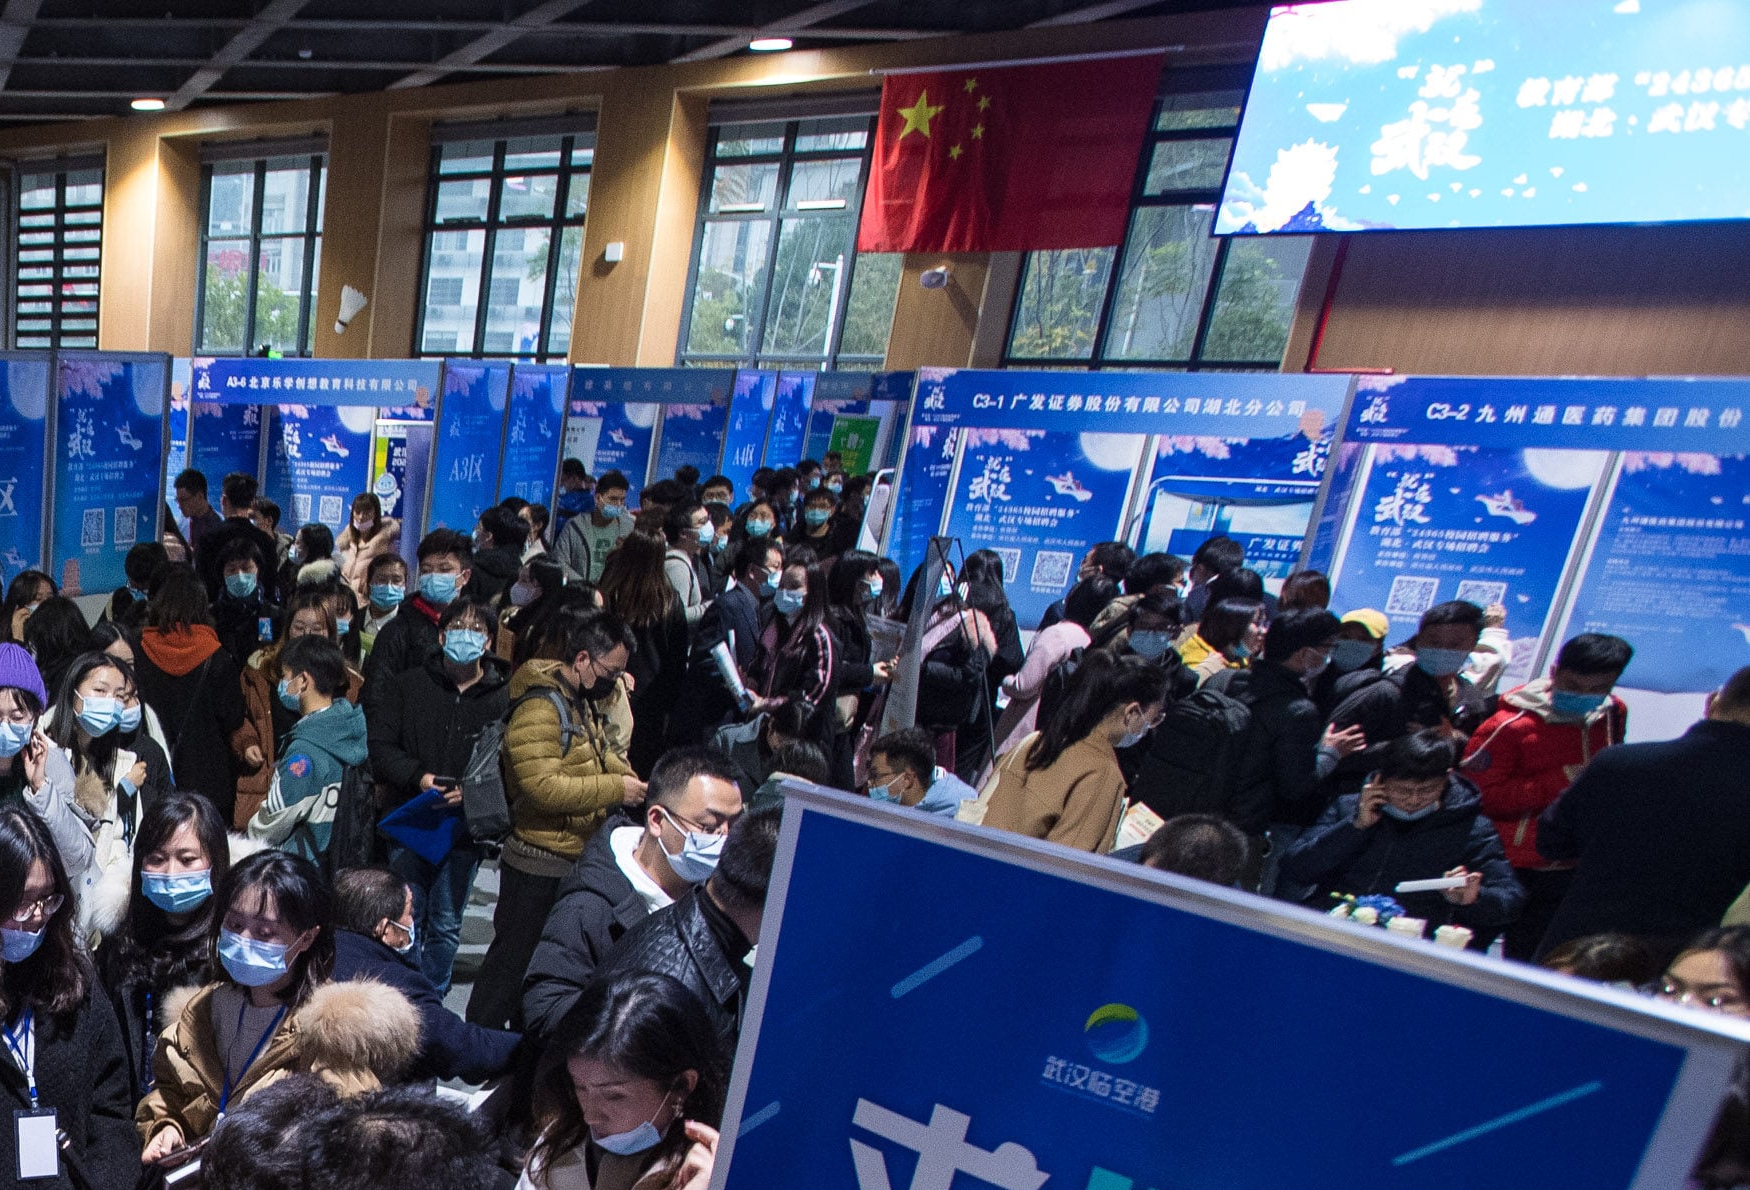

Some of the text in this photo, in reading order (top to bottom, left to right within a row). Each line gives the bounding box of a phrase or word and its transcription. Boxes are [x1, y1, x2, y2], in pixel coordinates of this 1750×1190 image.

[226, 376, 246, 388] A3-6
[972, 393, 1307, 418] C3-1 广发证券股份有限公司湖北分公司
[1426, 402, 1743, 429] C3-2 九州通医药集团股份
[449, 452, 485, 483] A3区
[1042, 1055, 1161, 1113] 武汉临空港
